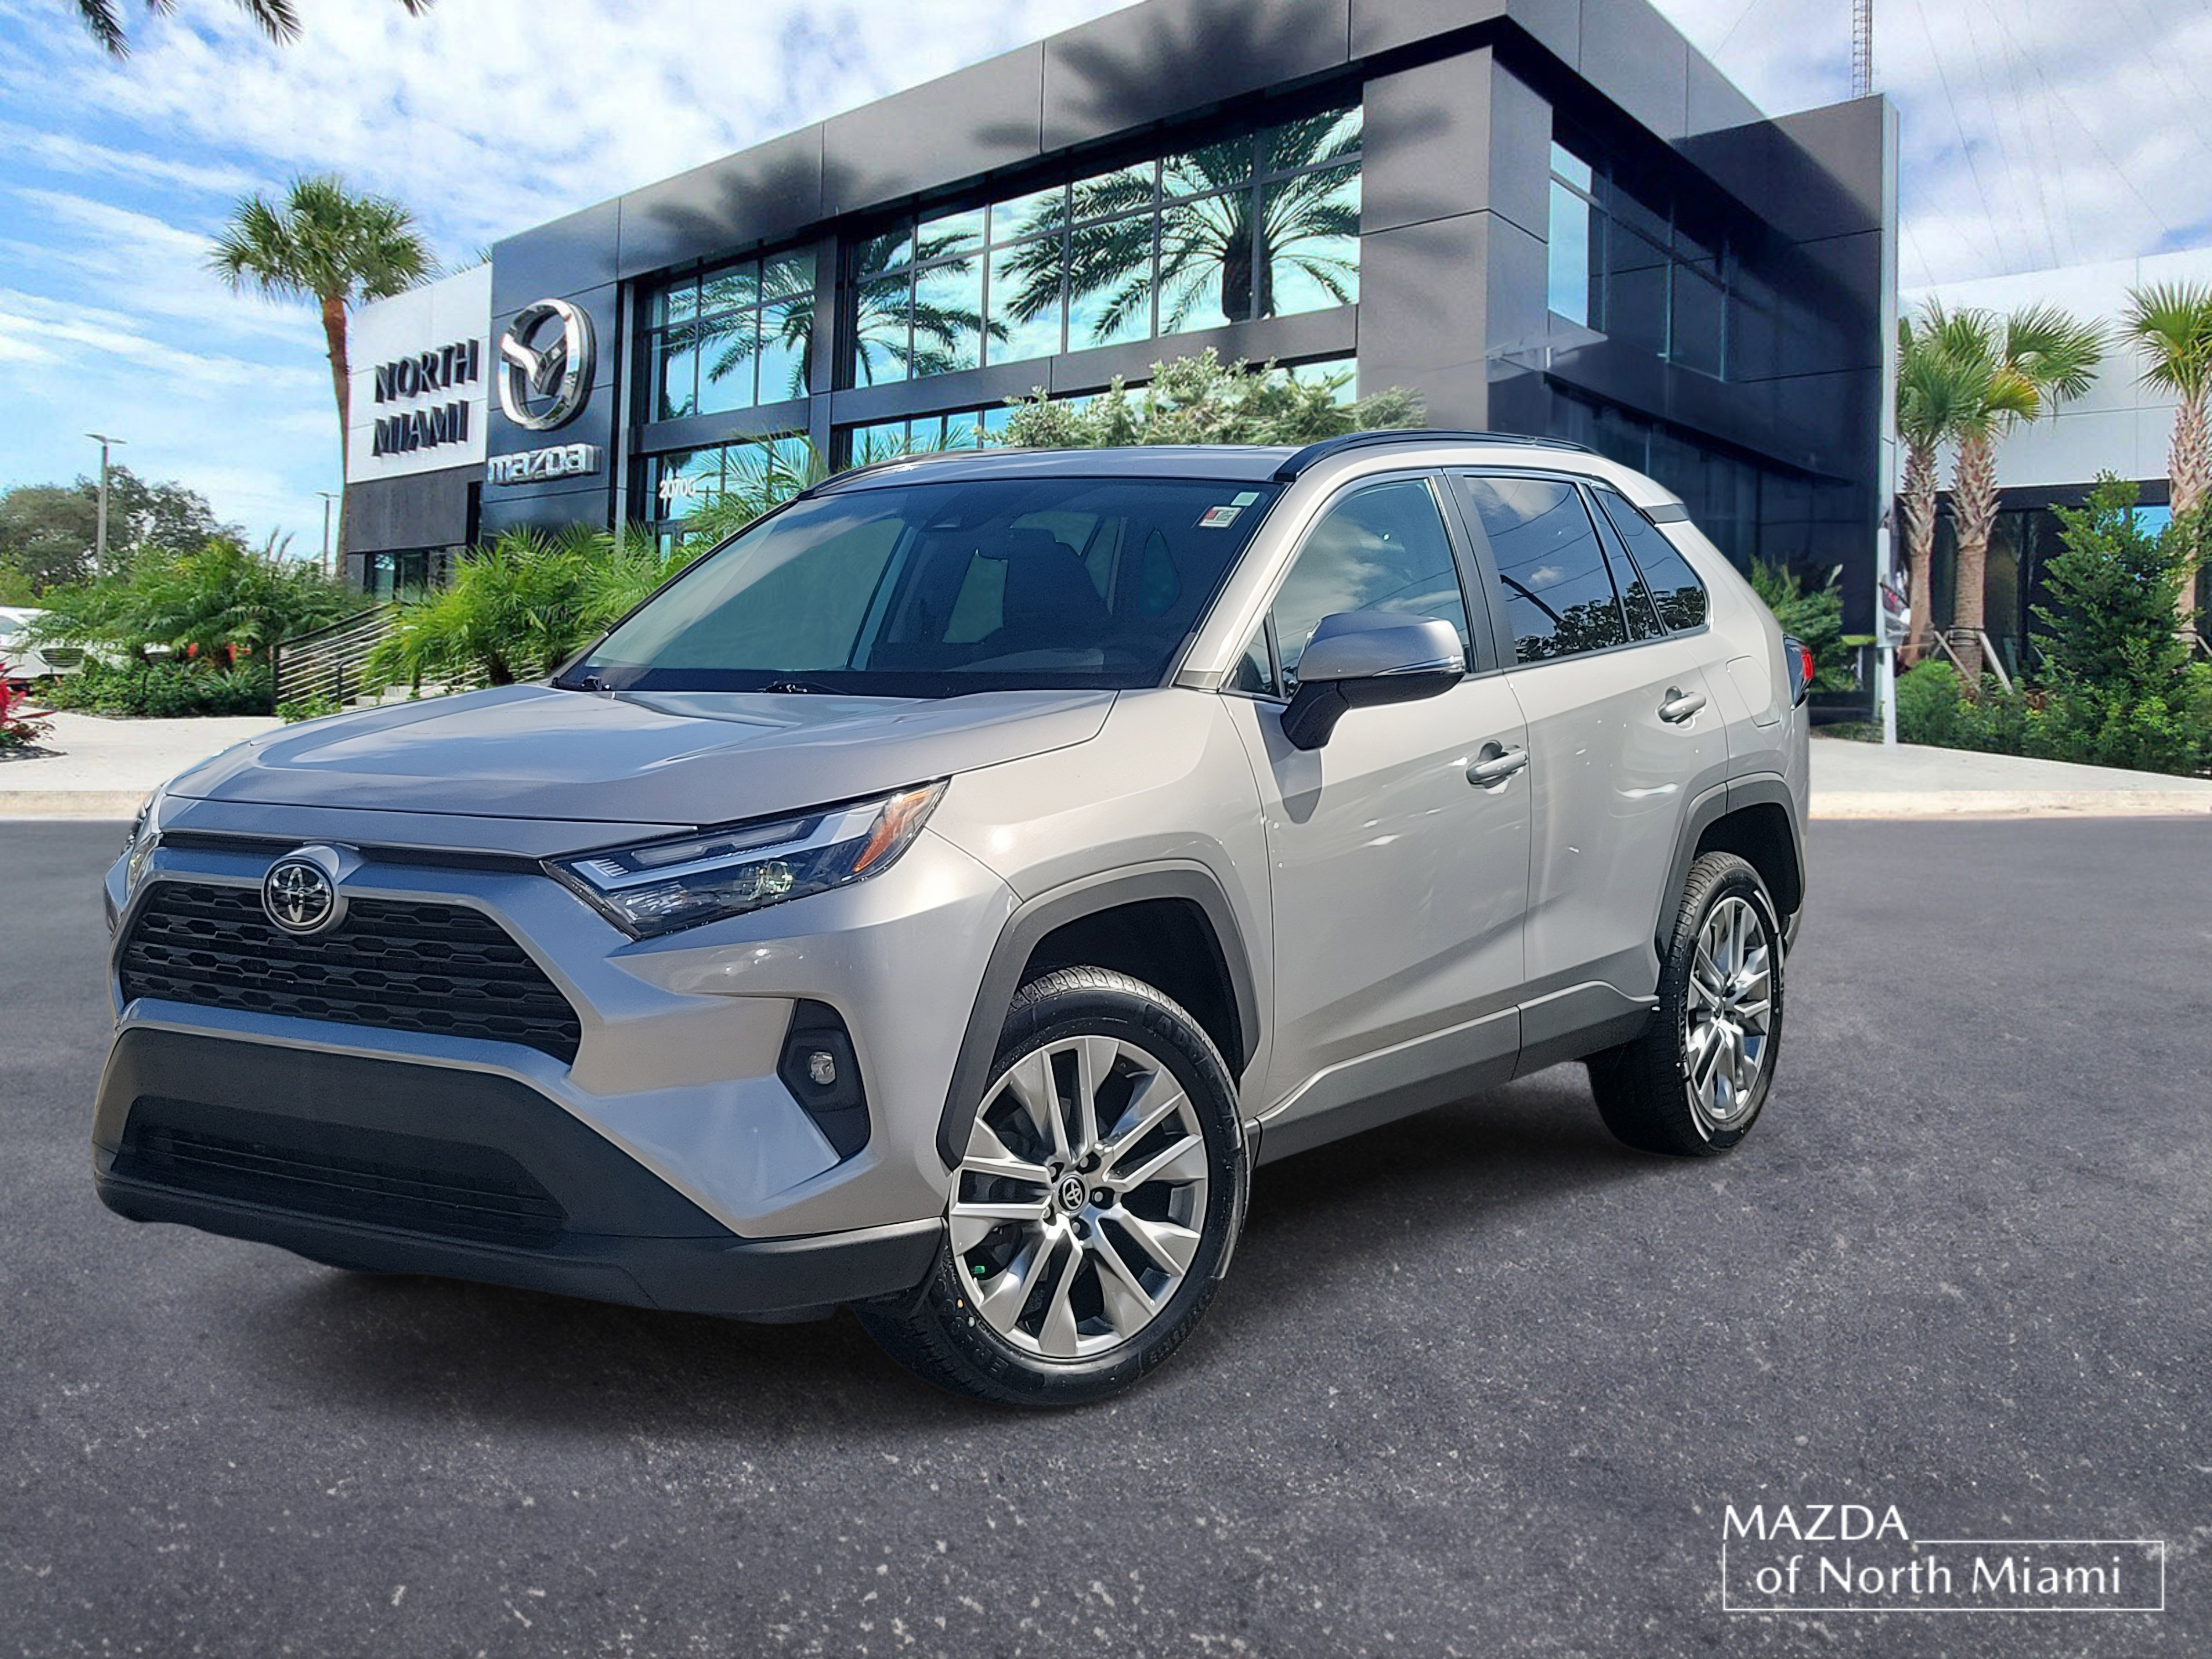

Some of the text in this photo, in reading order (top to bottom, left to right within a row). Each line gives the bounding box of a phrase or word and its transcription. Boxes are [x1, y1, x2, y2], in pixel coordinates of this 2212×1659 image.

[375, 338, 479, 403] NORTH
[373, 400, 469, 456] MIAMI
[488, 443, 599, 483] mazda
